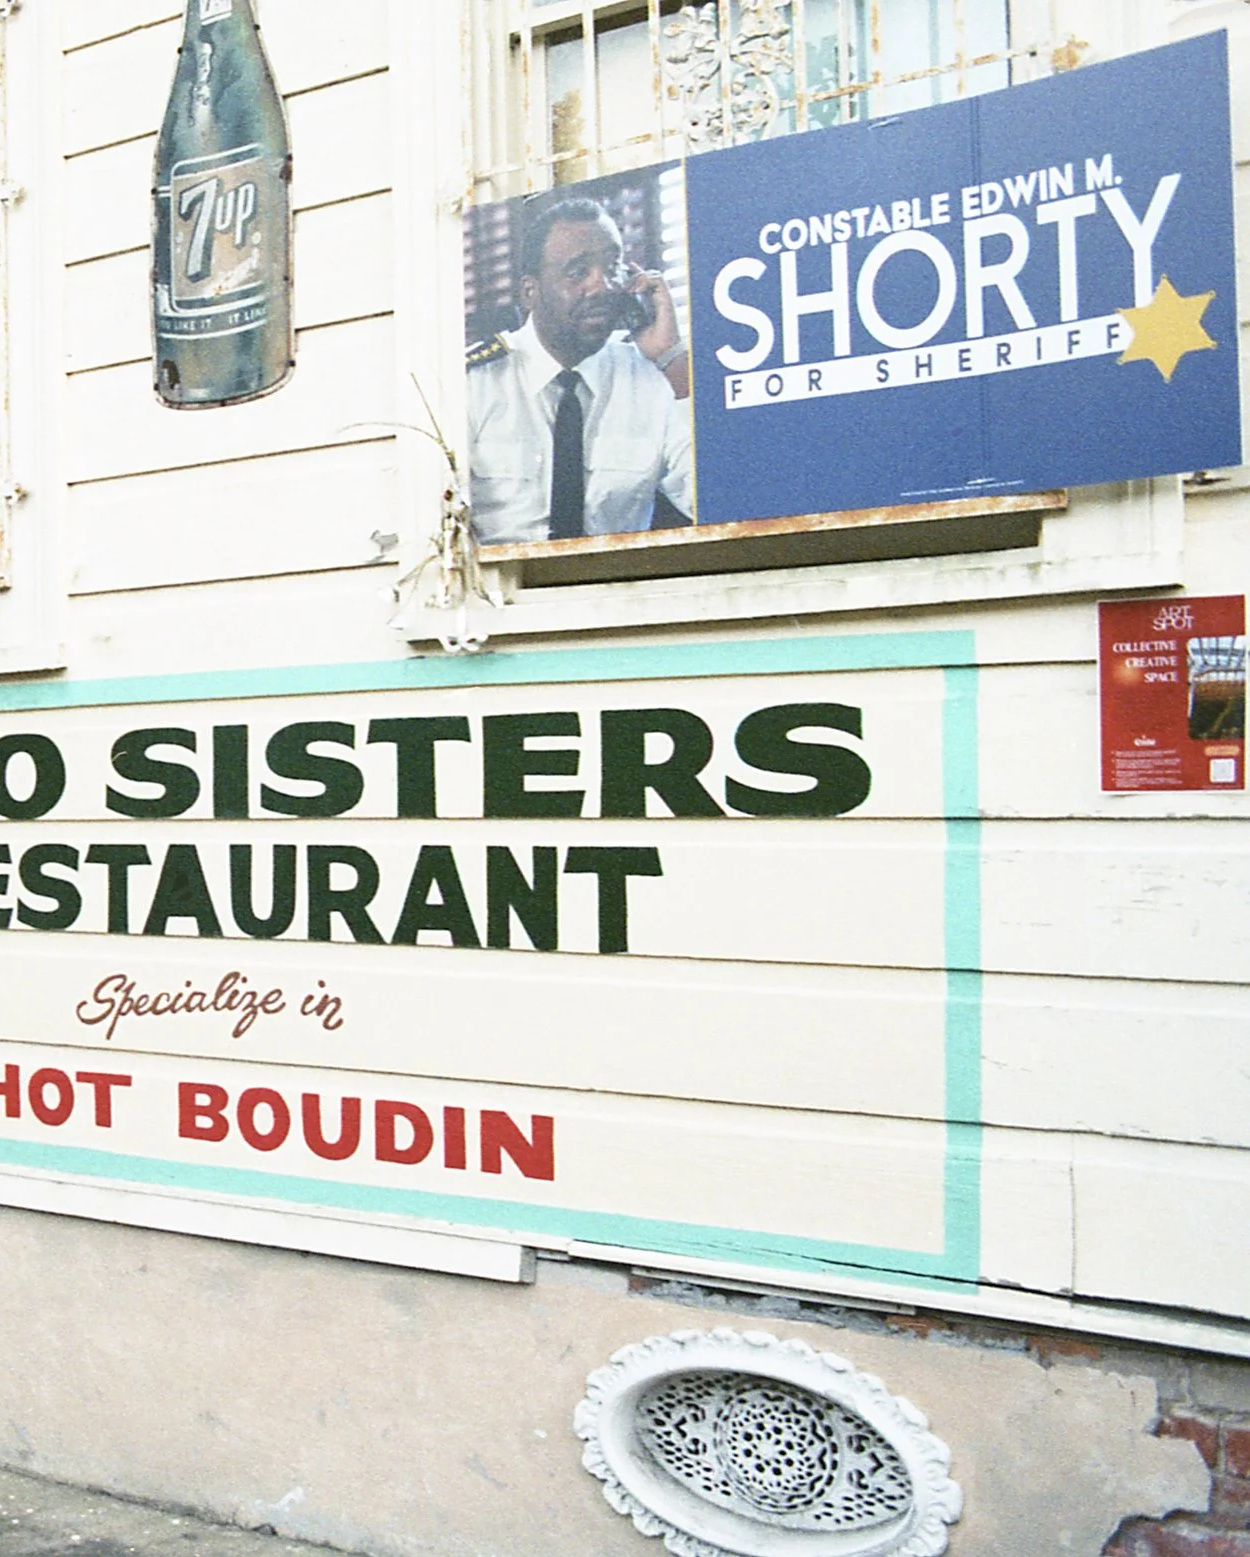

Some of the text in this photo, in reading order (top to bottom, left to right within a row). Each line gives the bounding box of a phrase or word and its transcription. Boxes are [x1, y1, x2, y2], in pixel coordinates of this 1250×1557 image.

[759, 153, 1123, 254] CONSTABLE EDWIN M.
[713, 173, 1181, 372] SHORTY
[731, 322, 1122, 402] FOR SHERIFF
[1112, 640, 1178, 653] COLLECTIVE
[1152, 616, 1195, 631] SPOT
[1158, 605, 1192, 621] ART
[1125, 656, 1178, 668] CREATIVE
[1144, 672, 1178, 683] SPACE
[106, 703, 872, 819] SISTERS
[75, 971, 344, 1041] Specialize in
[178, 1081, 555, 1182] BOUDIN
